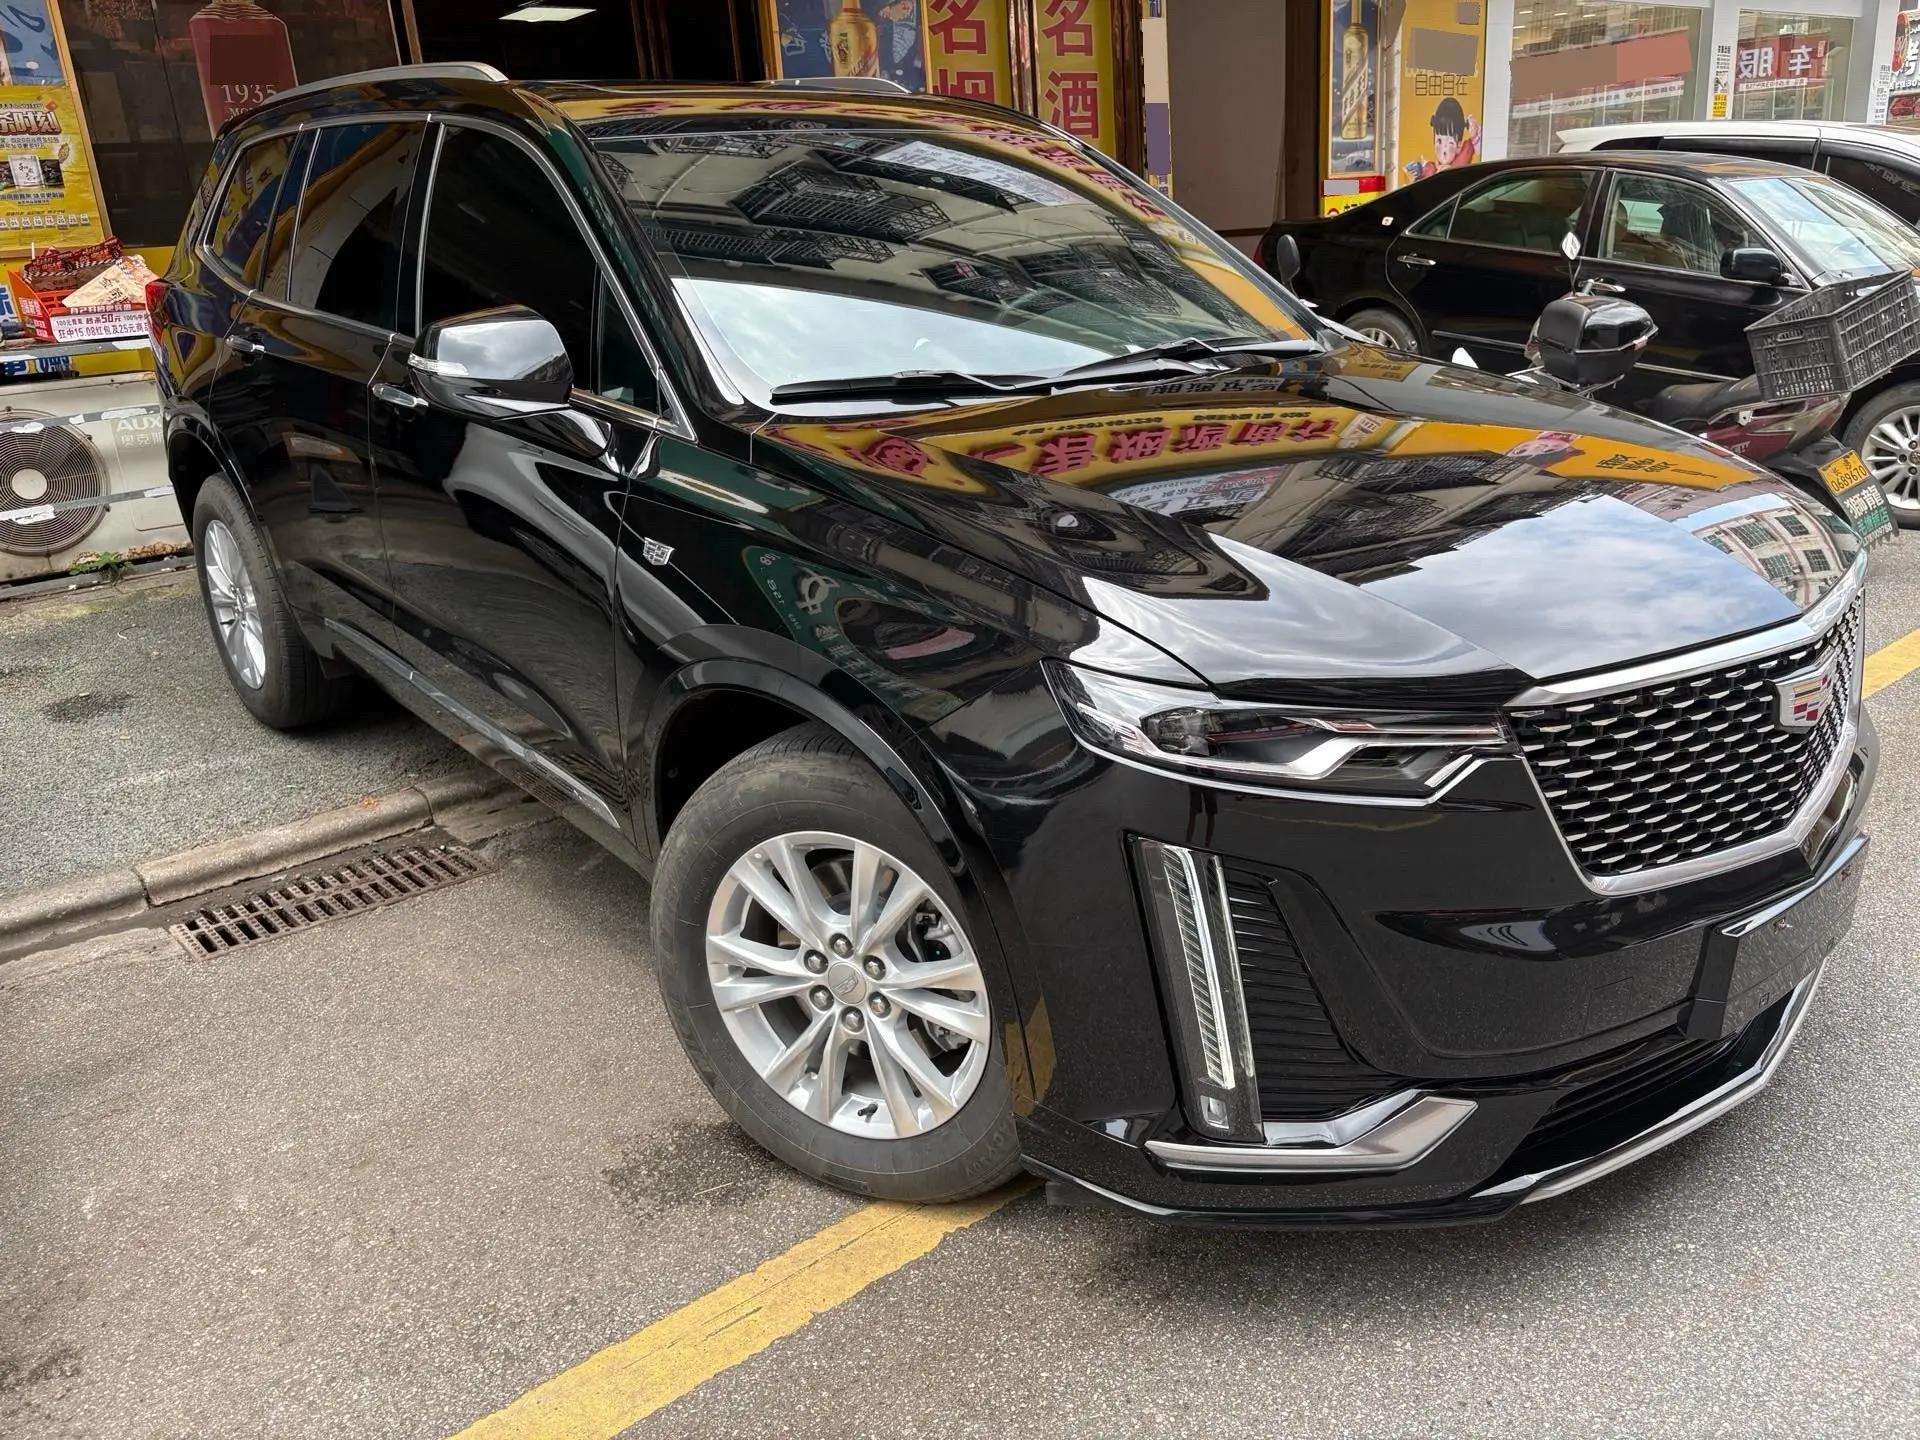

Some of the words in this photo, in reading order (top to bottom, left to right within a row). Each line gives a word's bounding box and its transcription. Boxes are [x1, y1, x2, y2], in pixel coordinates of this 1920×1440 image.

[1041, 0, 1099, 139] 名酒
[220, 84, 278, 104] 1935
[1415, 74, 1469, 96] 自由自在
[116, 416, 162, 432] AUX
[1831, 466, 1868, 492] 0689670
